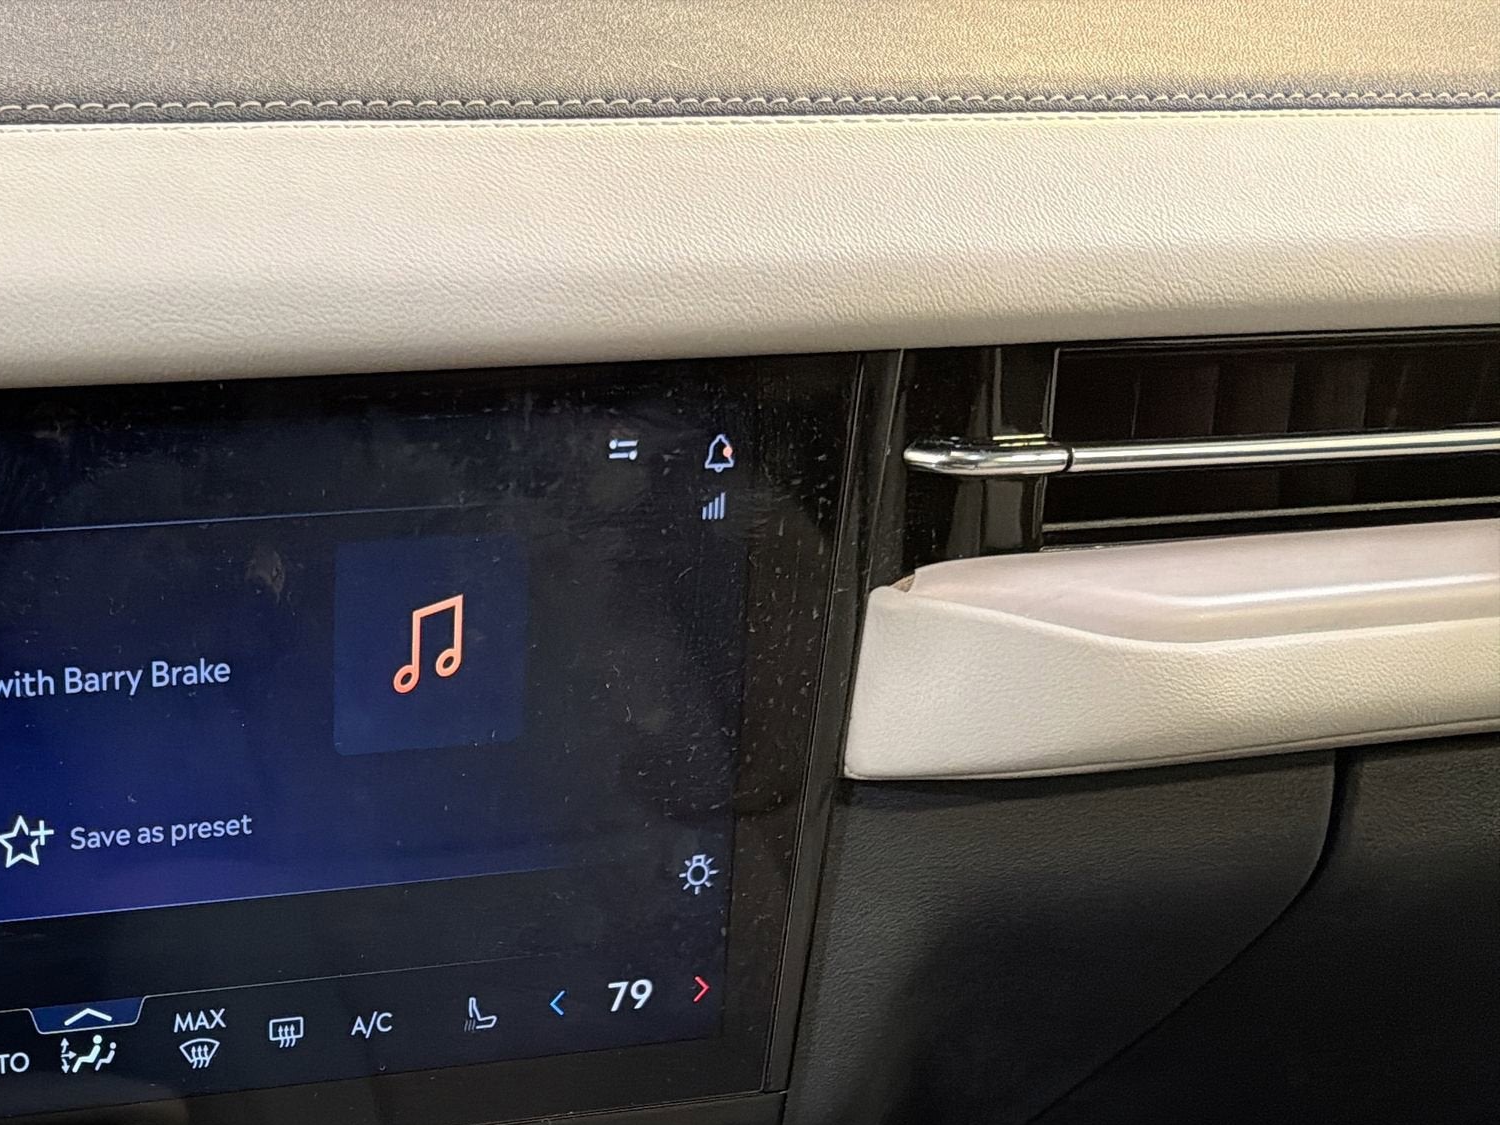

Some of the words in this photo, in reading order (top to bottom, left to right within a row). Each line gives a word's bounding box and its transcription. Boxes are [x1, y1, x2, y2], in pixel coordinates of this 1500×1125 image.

[64, 666, 143, 696] Barry
[151, 658, 232, 688] Brake
[70, 826, 131, 850] Save
[137, 825, 165, 844] as
[171, 814, 253, 847] preset
[607, 979, 654, 1014] 79
[173, 1008, 227, 1033] MAX
[351, 1011, 394, 1036] A/C
